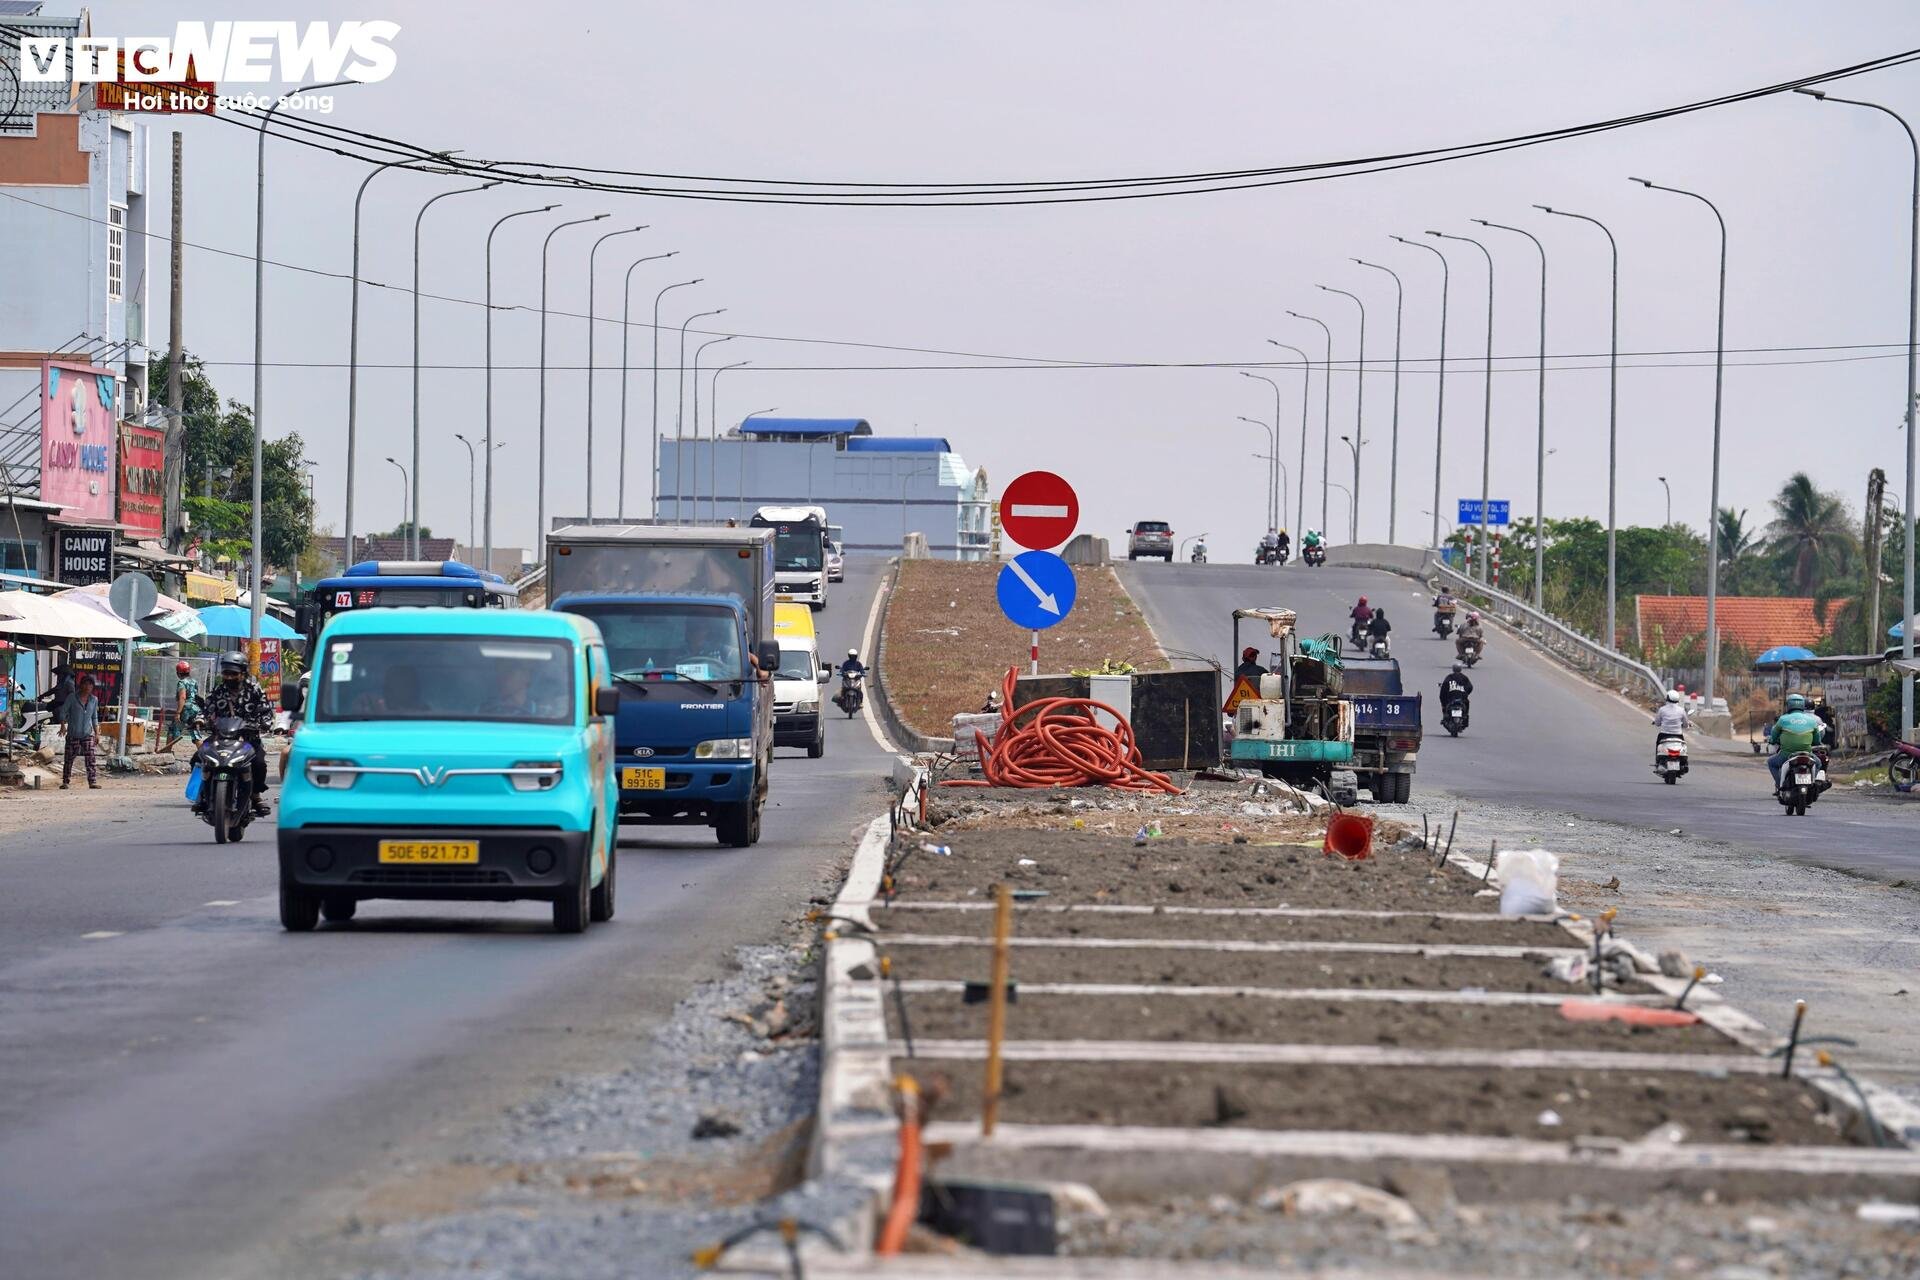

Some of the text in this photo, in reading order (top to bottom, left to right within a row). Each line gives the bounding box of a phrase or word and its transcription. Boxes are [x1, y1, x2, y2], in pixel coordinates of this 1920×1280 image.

[49, 440, 79, 469] CANDY
[65, 537, 107, 552] CANDY
[65, 557, 106, 571] HOUSE
[337, 594, 350, 606] 47
[264, 640, 277, 653] XE
[1387, 704, 1400, 715] 38
[1269, 744, 1297, 757] IHI
[635, 769, 653, 778] 51C
[627, 779, 660, 788] 993.65
